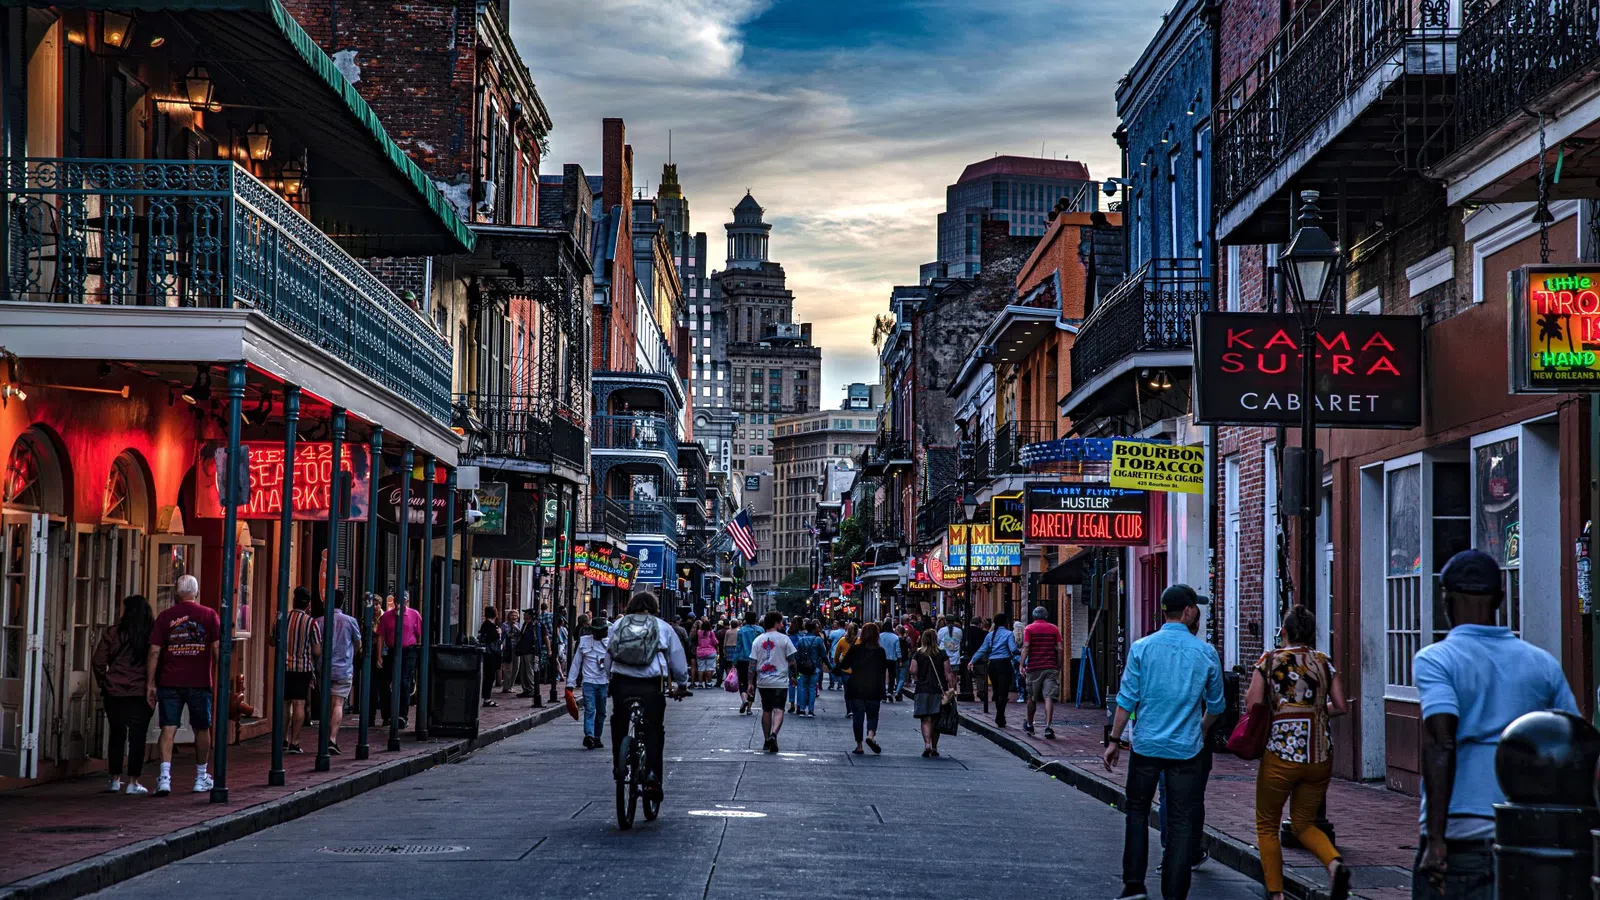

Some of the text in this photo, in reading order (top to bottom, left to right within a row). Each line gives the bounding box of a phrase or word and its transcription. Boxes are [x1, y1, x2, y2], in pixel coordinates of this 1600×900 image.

[1227, 328, 1395, 351] KAMA
[1541, 351, 1596, 367] HAND
[1240, 392, 1379, 412] CABARET
[301, 444, 350, 460] 424
[1115, 444, 1204, 462] BOURBON
[1117, 457, 1203, 474] TOBACCO
[1113, 469, 1164, 481] CIGARETTES
[1174, 474, 1204, 484] CIGARS
[244, 485, 332, 513] MARKE
[389, 487, 447, 507] Bouron
[1086, 488, 1125, 496] FLYNT'S
[1003, 500, 1024, 511] The
[1061, 497, 1109, 509] HUSTLER
[1031, 513, 1143, 539] BARELY LEGAL CLUB
[971, 544, 999, 555] SEAFOOD
[960, 556, 983, 566] OYTERS
